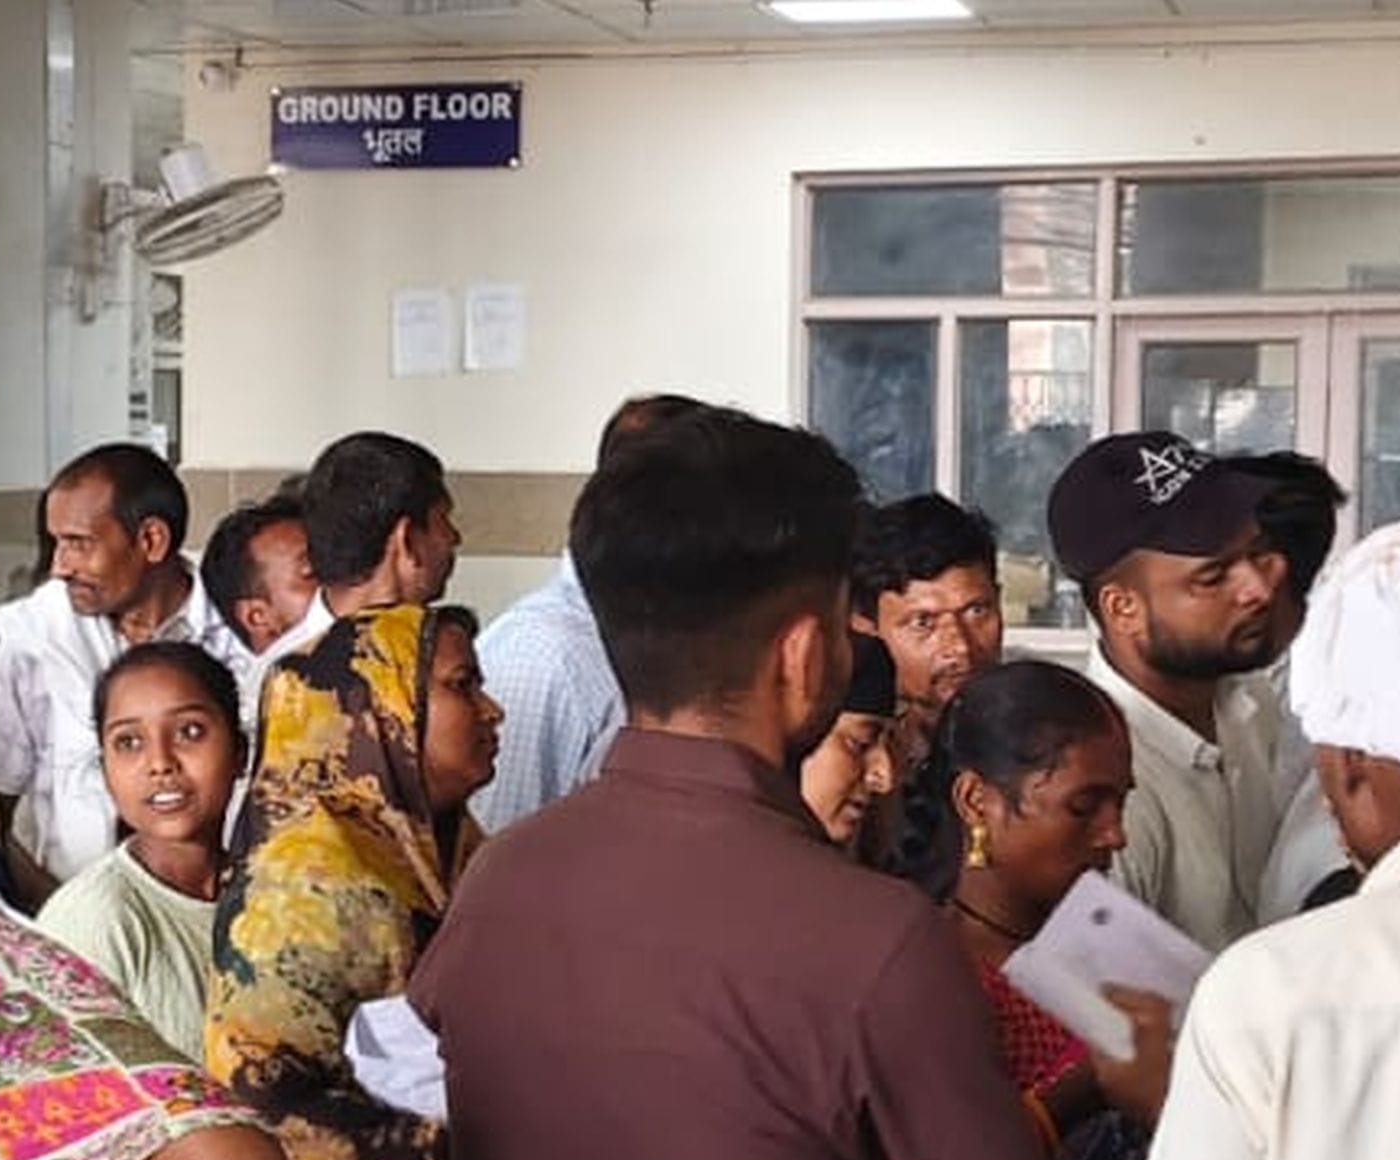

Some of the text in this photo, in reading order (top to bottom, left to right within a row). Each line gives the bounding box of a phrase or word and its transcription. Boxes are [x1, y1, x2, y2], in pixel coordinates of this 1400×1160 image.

[278, 92, 513, 124] GROUND FLOOR
[362, 127, 424, 163] भूतल
